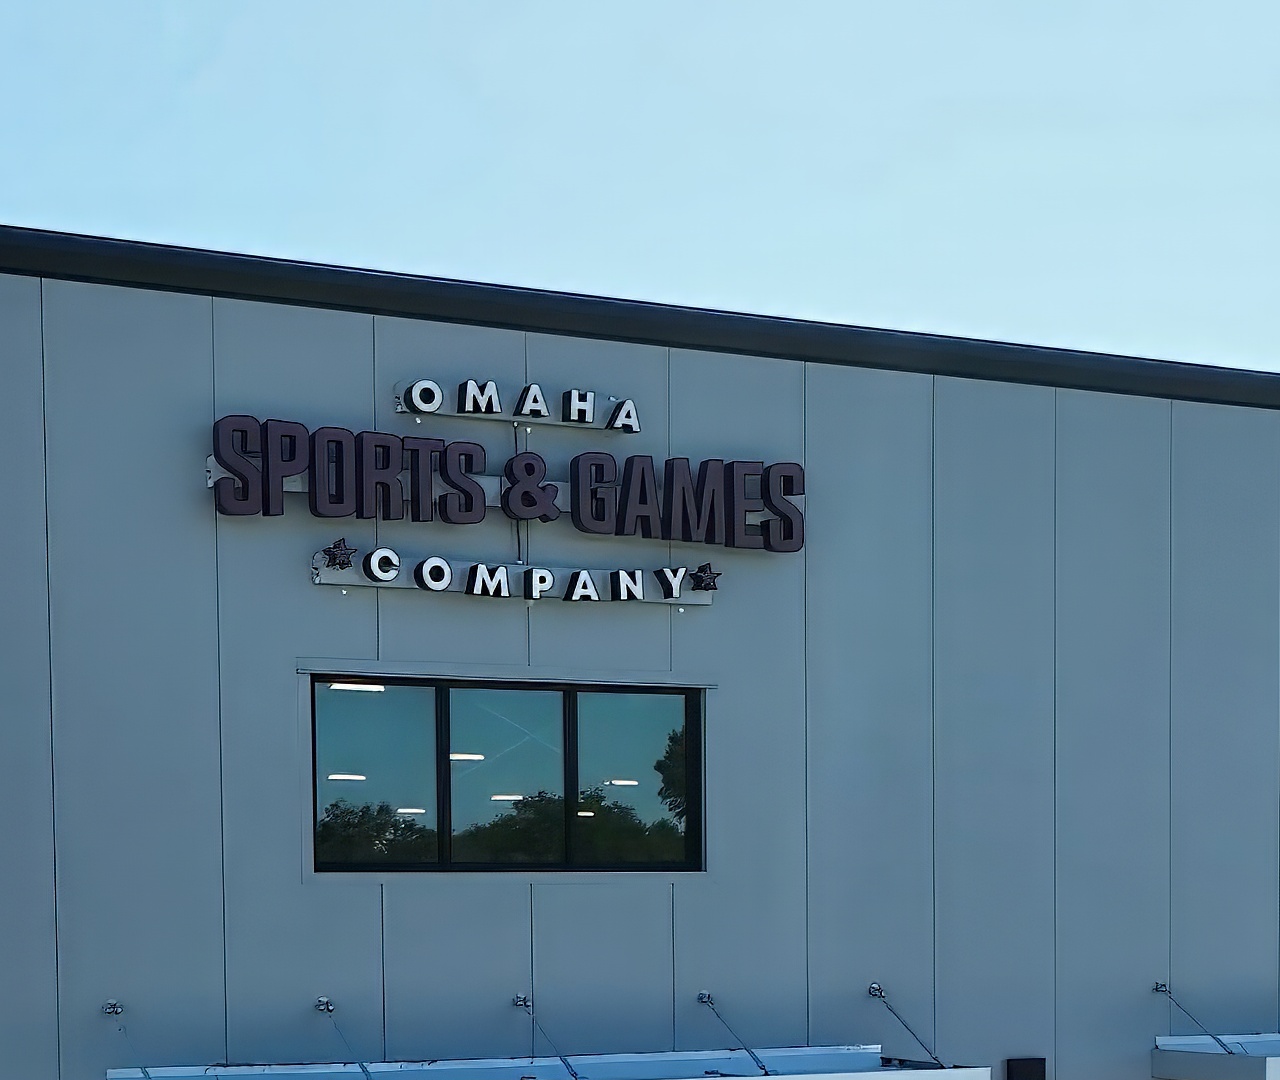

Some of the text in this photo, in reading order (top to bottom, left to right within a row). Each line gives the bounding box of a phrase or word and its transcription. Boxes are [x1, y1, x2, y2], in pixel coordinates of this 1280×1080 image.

[403, 378, 641, 433] OMAHA
[213, 415, 805, 553] SPORTS & GAMES
[362, 547, 688, 602] COMPANY
